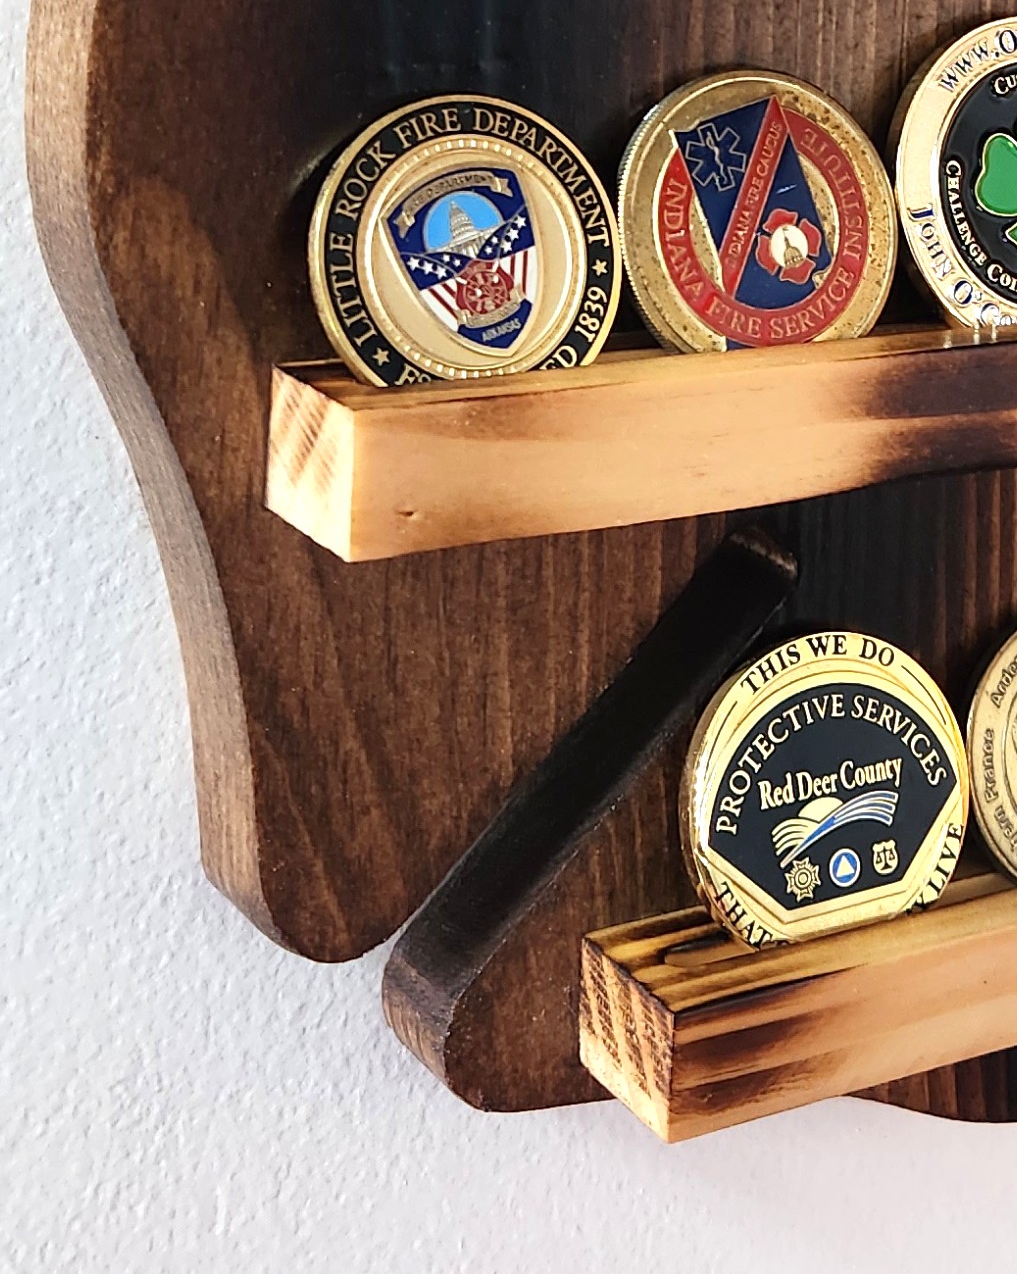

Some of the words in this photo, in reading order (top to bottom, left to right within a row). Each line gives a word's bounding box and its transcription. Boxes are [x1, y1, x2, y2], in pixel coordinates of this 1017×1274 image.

[393, 107, 462, 150] FIRE
[335, 140, 397, 221] ROCK
[472, 107, 611, 249] DEPARTMENT
[800, 127, 863, 261] INSTITUTE
[944, 159, 988, 267] CHALLENGE
[663, 177, 706, 303] INDIANA
[908, 203, 954, 281] JOHN
[328, 232, 372, 348] LITTLE
[574, 287, 608, 344] 1839
[705, 295, 762, 339] FIRE
[768, 267, 855, 340] SERVICE
[740, 643, 801, 695] THIS
[805, 634, 848, 658] WE
[859, 637, 895, 667] DO
[715, 694, 846, 836] PROTECTIVE
[850, 693, 948, 788] SERVICES
[757, 772, 796, 810] Red
[796, 771, 838, 801] Deer
[839, 757, 903, 788] County
[983, 727, 999, 804] France
[927, 822, 964, 892] LIVE
[714, 881, 775, 951] THAT
